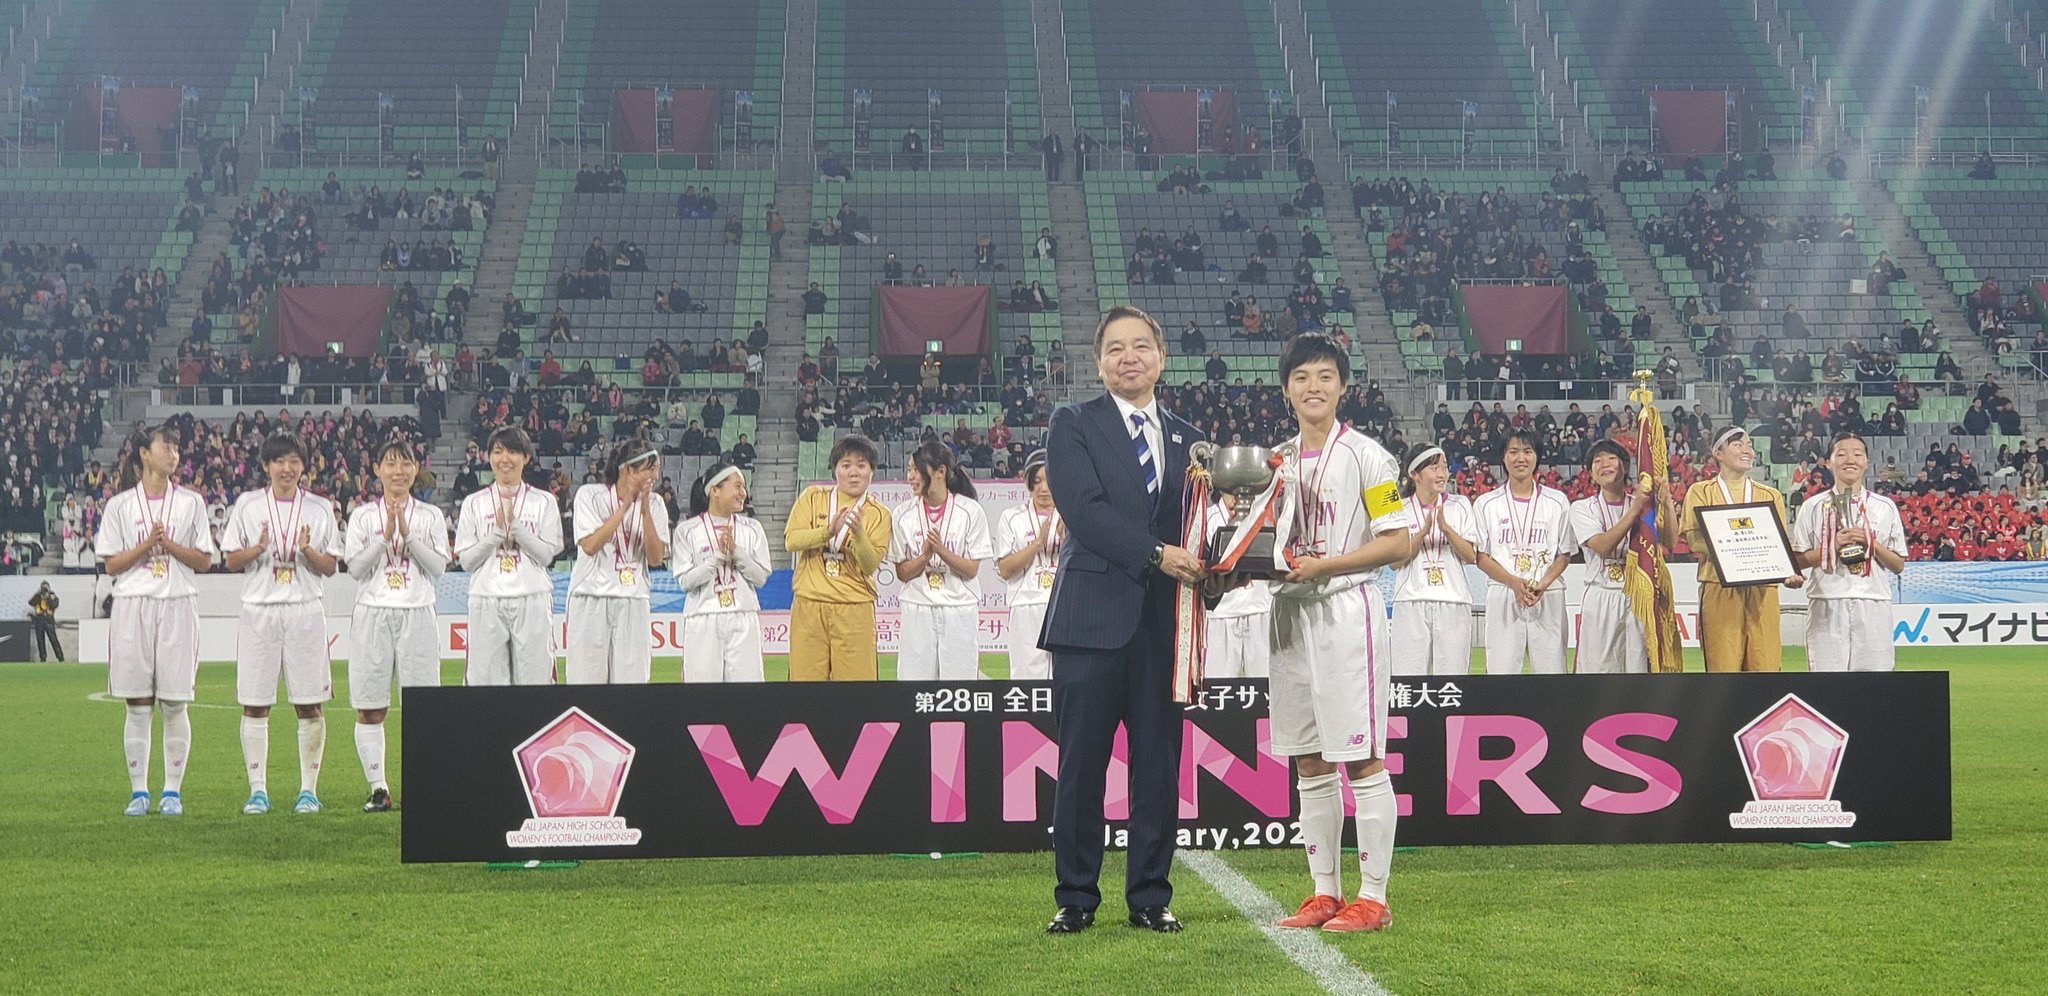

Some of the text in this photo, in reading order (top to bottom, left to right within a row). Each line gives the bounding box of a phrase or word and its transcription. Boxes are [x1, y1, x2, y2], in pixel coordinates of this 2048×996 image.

[1499, 528, 1549, 544] JUHIN
[914, 688, 993, 713] 第28回
[1760, 804, 1784, 814] JAPAN
[1786, 804, 1805, 813] HIGH
[1807, 803, 1839, 813] SCHOOL
[1769, 815, 1801, 825] FOOTBALL
[1803, 814, 1853, 825] CHAMPIONSHIP
[539, 821, 565, 831] JAPAN
[567, 821, 588, 830] HIGH
[589, 820, 623, 830] SCHOOL
[548, 833, 582, 843] FOOTBALL
[584, 832, 638, 843] CHAMPIONSHIP
